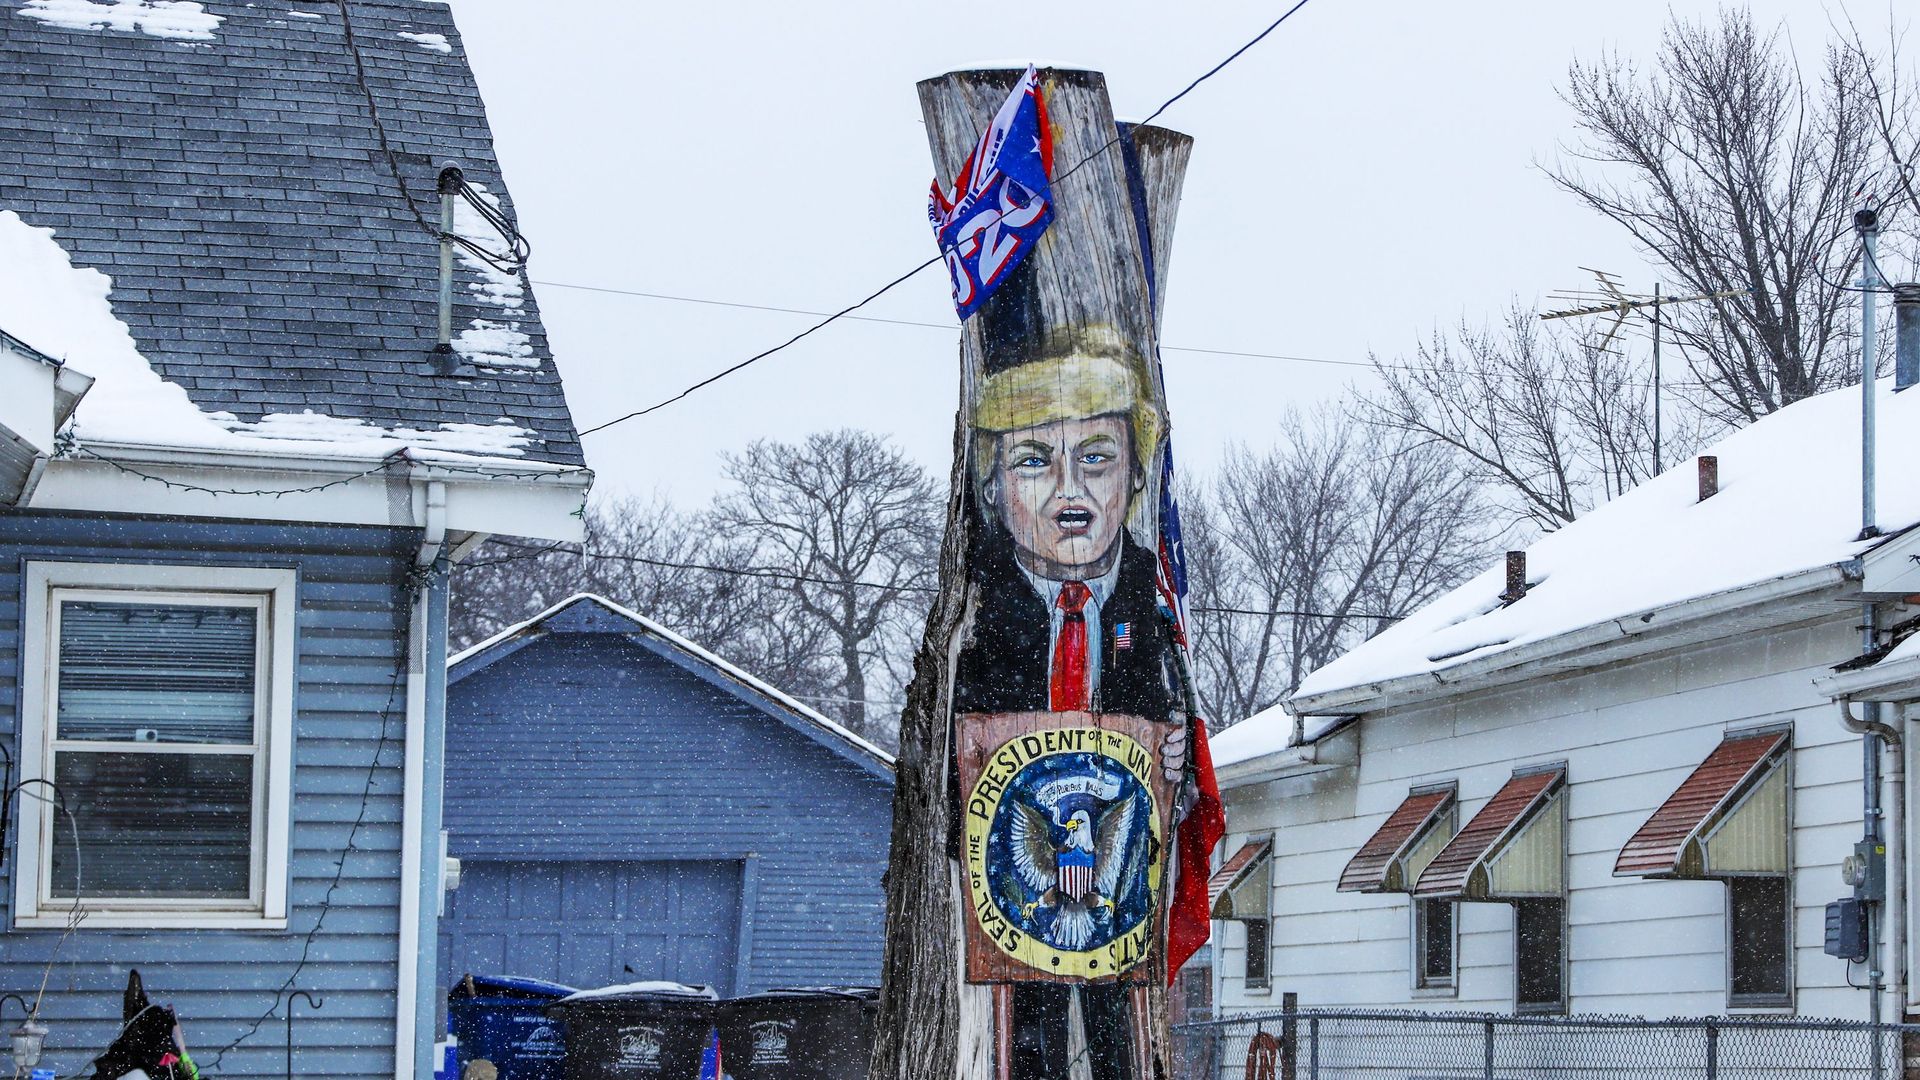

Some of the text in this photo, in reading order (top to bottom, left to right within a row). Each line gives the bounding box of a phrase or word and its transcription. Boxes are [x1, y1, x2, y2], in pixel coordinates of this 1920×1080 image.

[1107, 735, 1122, 748] THE
[969, 729, 1086, 821] PRESIDENT
[970, 834, 980, 863] THE
[971, 870, 981, 889] OF
[977, 891, 1021, 952] SEAL
